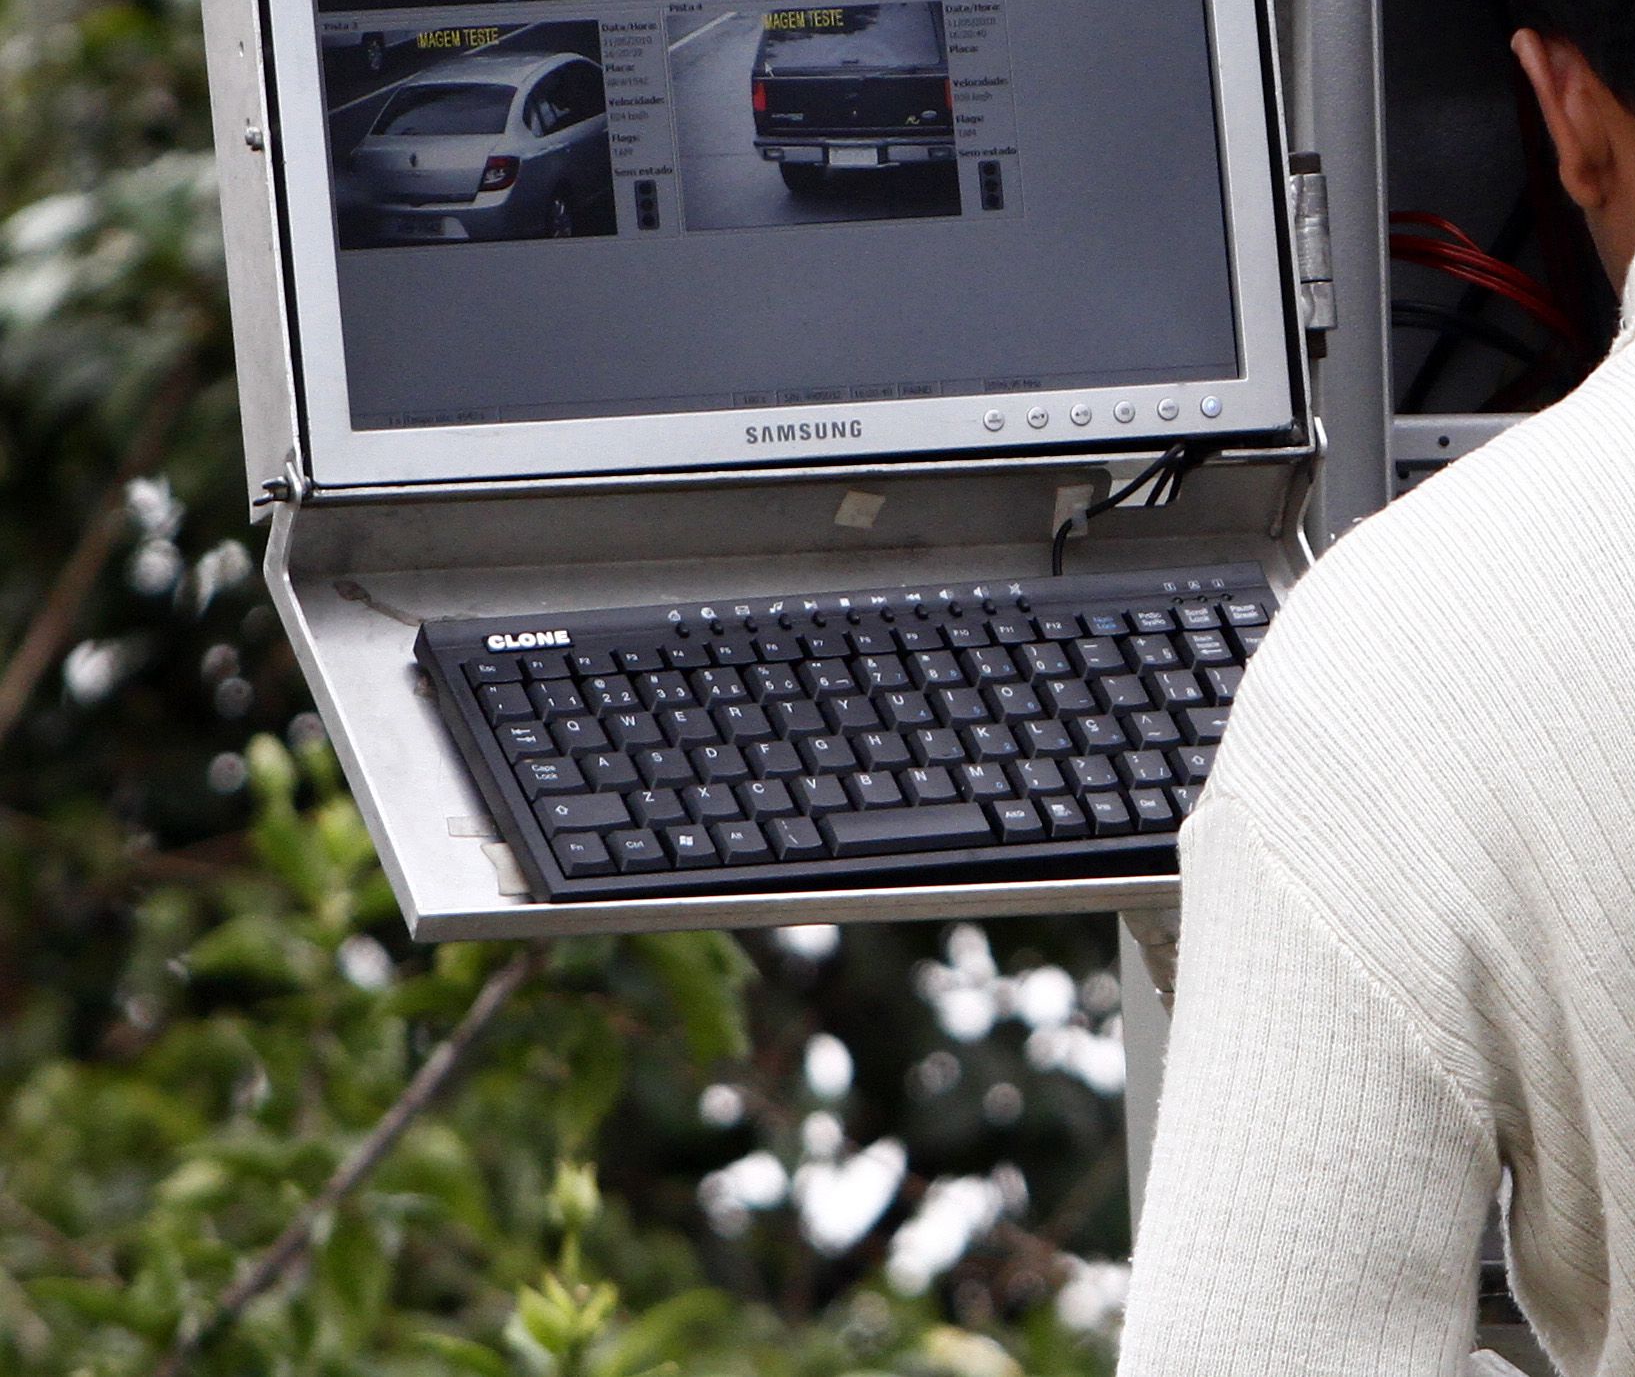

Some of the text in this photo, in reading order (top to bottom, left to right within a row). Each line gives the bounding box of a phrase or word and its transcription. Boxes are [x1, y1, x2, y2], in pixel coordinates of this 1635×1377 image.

[668, 3, 697, 12] Pista
[762, 9, 844, 30] IMAGEM TESTE
[416, 28, 499, 49] IMAGEM TESTE
[745, 419, 863, 444] SAMSUNG
[1046, 622, 1062, 630] F12
[953, 629, 970, 637] F10
[487, 630, 571, 649] CLONE
[533, 661, 543, 669] F1
[579, 657, 591, 665] F2
[1001, 687, 1013, 697] O
[1053, 683, 1065, 693] P
[892, 694, 905, 706] U
[946, 690, 954, 701] I
[782, 702, 794, 713] T
[837, 699, 849, 710] Y
[674, 711, 687, 722] E
[729, 706, 742, 718] R
[566, 720, 580, 732] Q
[619, 715, 636, 727] W
[976, 726, 990, 738] K
[1030, 723, 1043, 734] L
[868, 734, 882, 746] H
[924, 731, 934, 742] J
[759, 743, 770, 754] F
[815, 739, 829, 750] G
[651, 751, 663, 763] S
[705, 747, 718, 759] D
[598, 756, 610, 768] A
[531, 764, 557, 773] Caps
[968, 765, 985, 777] M
[535, 772, 559, 780] Lock
[860, 774, 873, 786] B
[913, 770, 928, 782] N
[752, 782, 765, 794] C
[806, 778, 817, 790] V
[643, 791, 655, 802] Z
[698, 786, 711, 799] X
[569, 843, 585, 852] Fn
[625, 840, 645, 849] Ctrl
